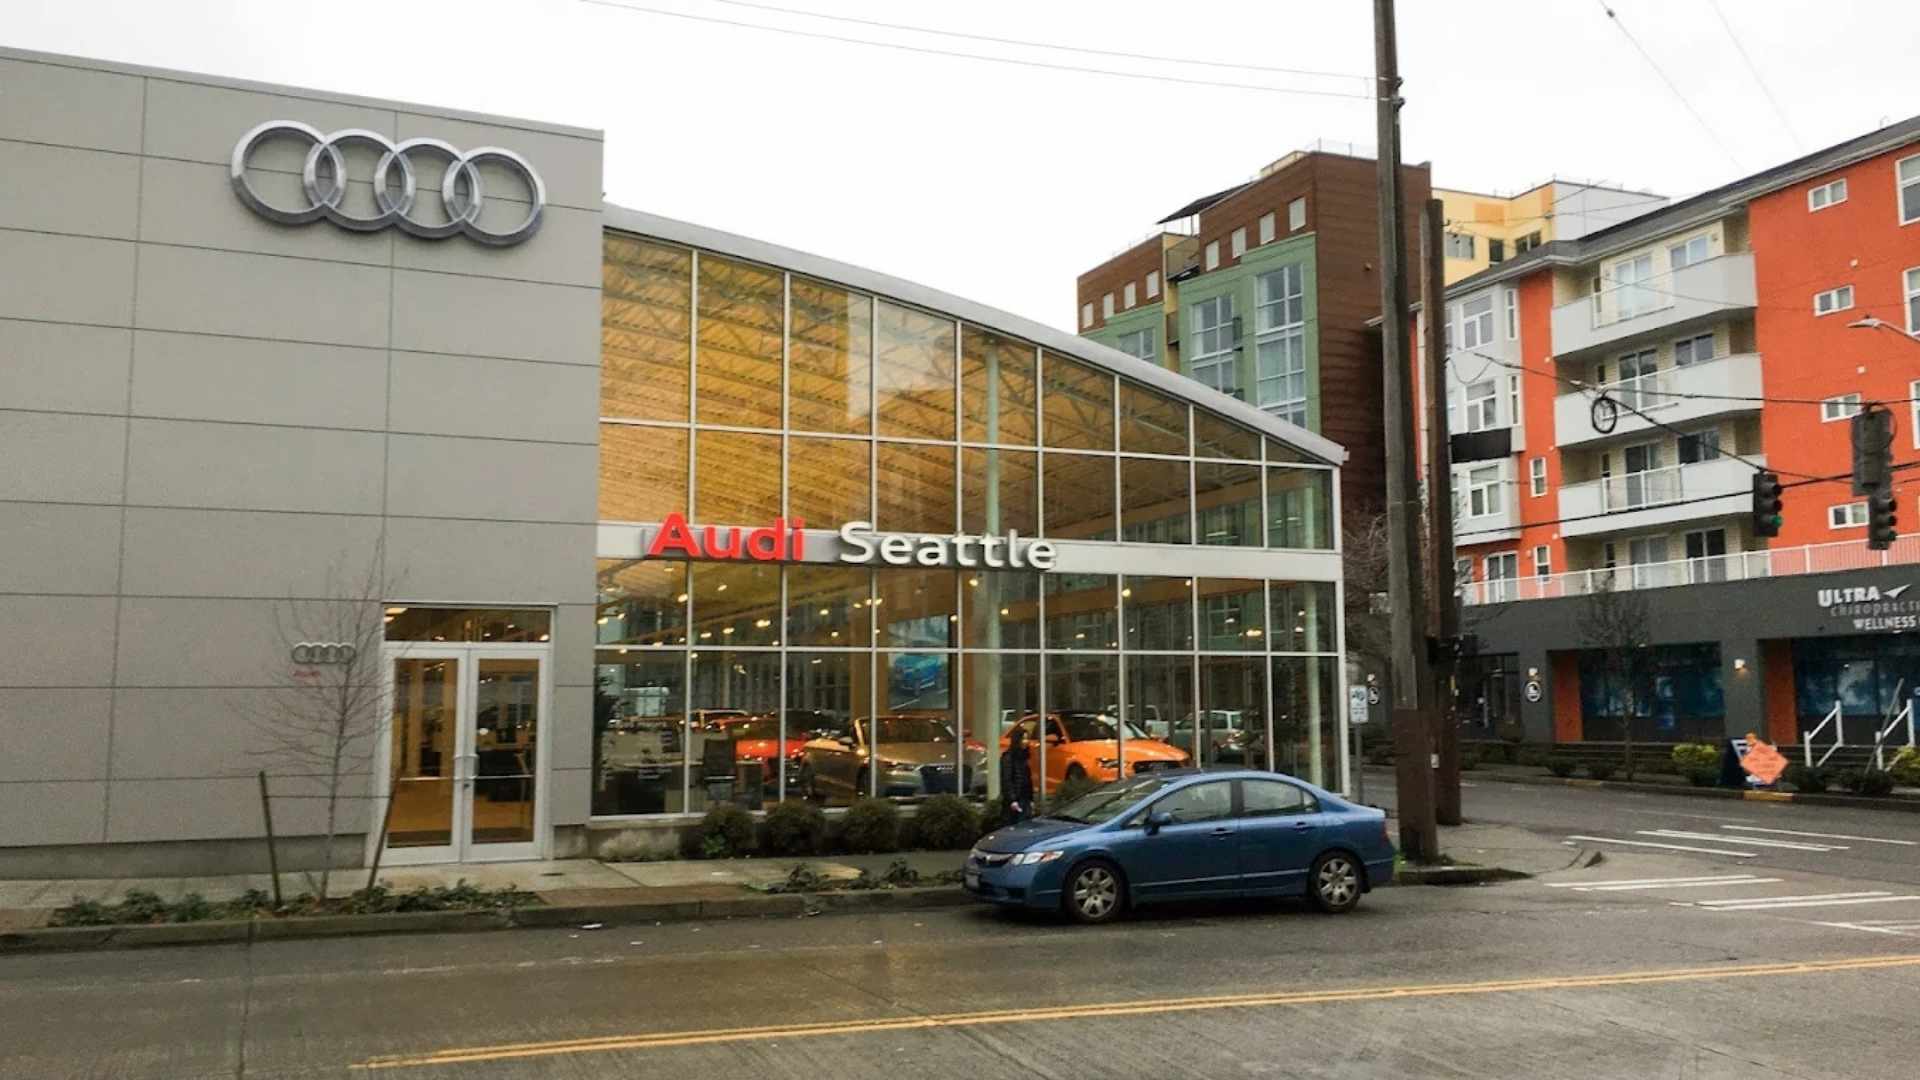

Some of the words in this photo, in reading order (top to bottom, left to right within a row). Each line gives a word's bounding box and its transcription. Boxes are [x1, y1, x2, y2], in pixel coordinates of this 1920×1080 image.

[648, 511, 806, 561] Audi
[840, 520, 1057, 569] Seattle
[1817, 585, 1881, 607] ULTRA
[1853, 615, 1917, 630] WELLNESS
